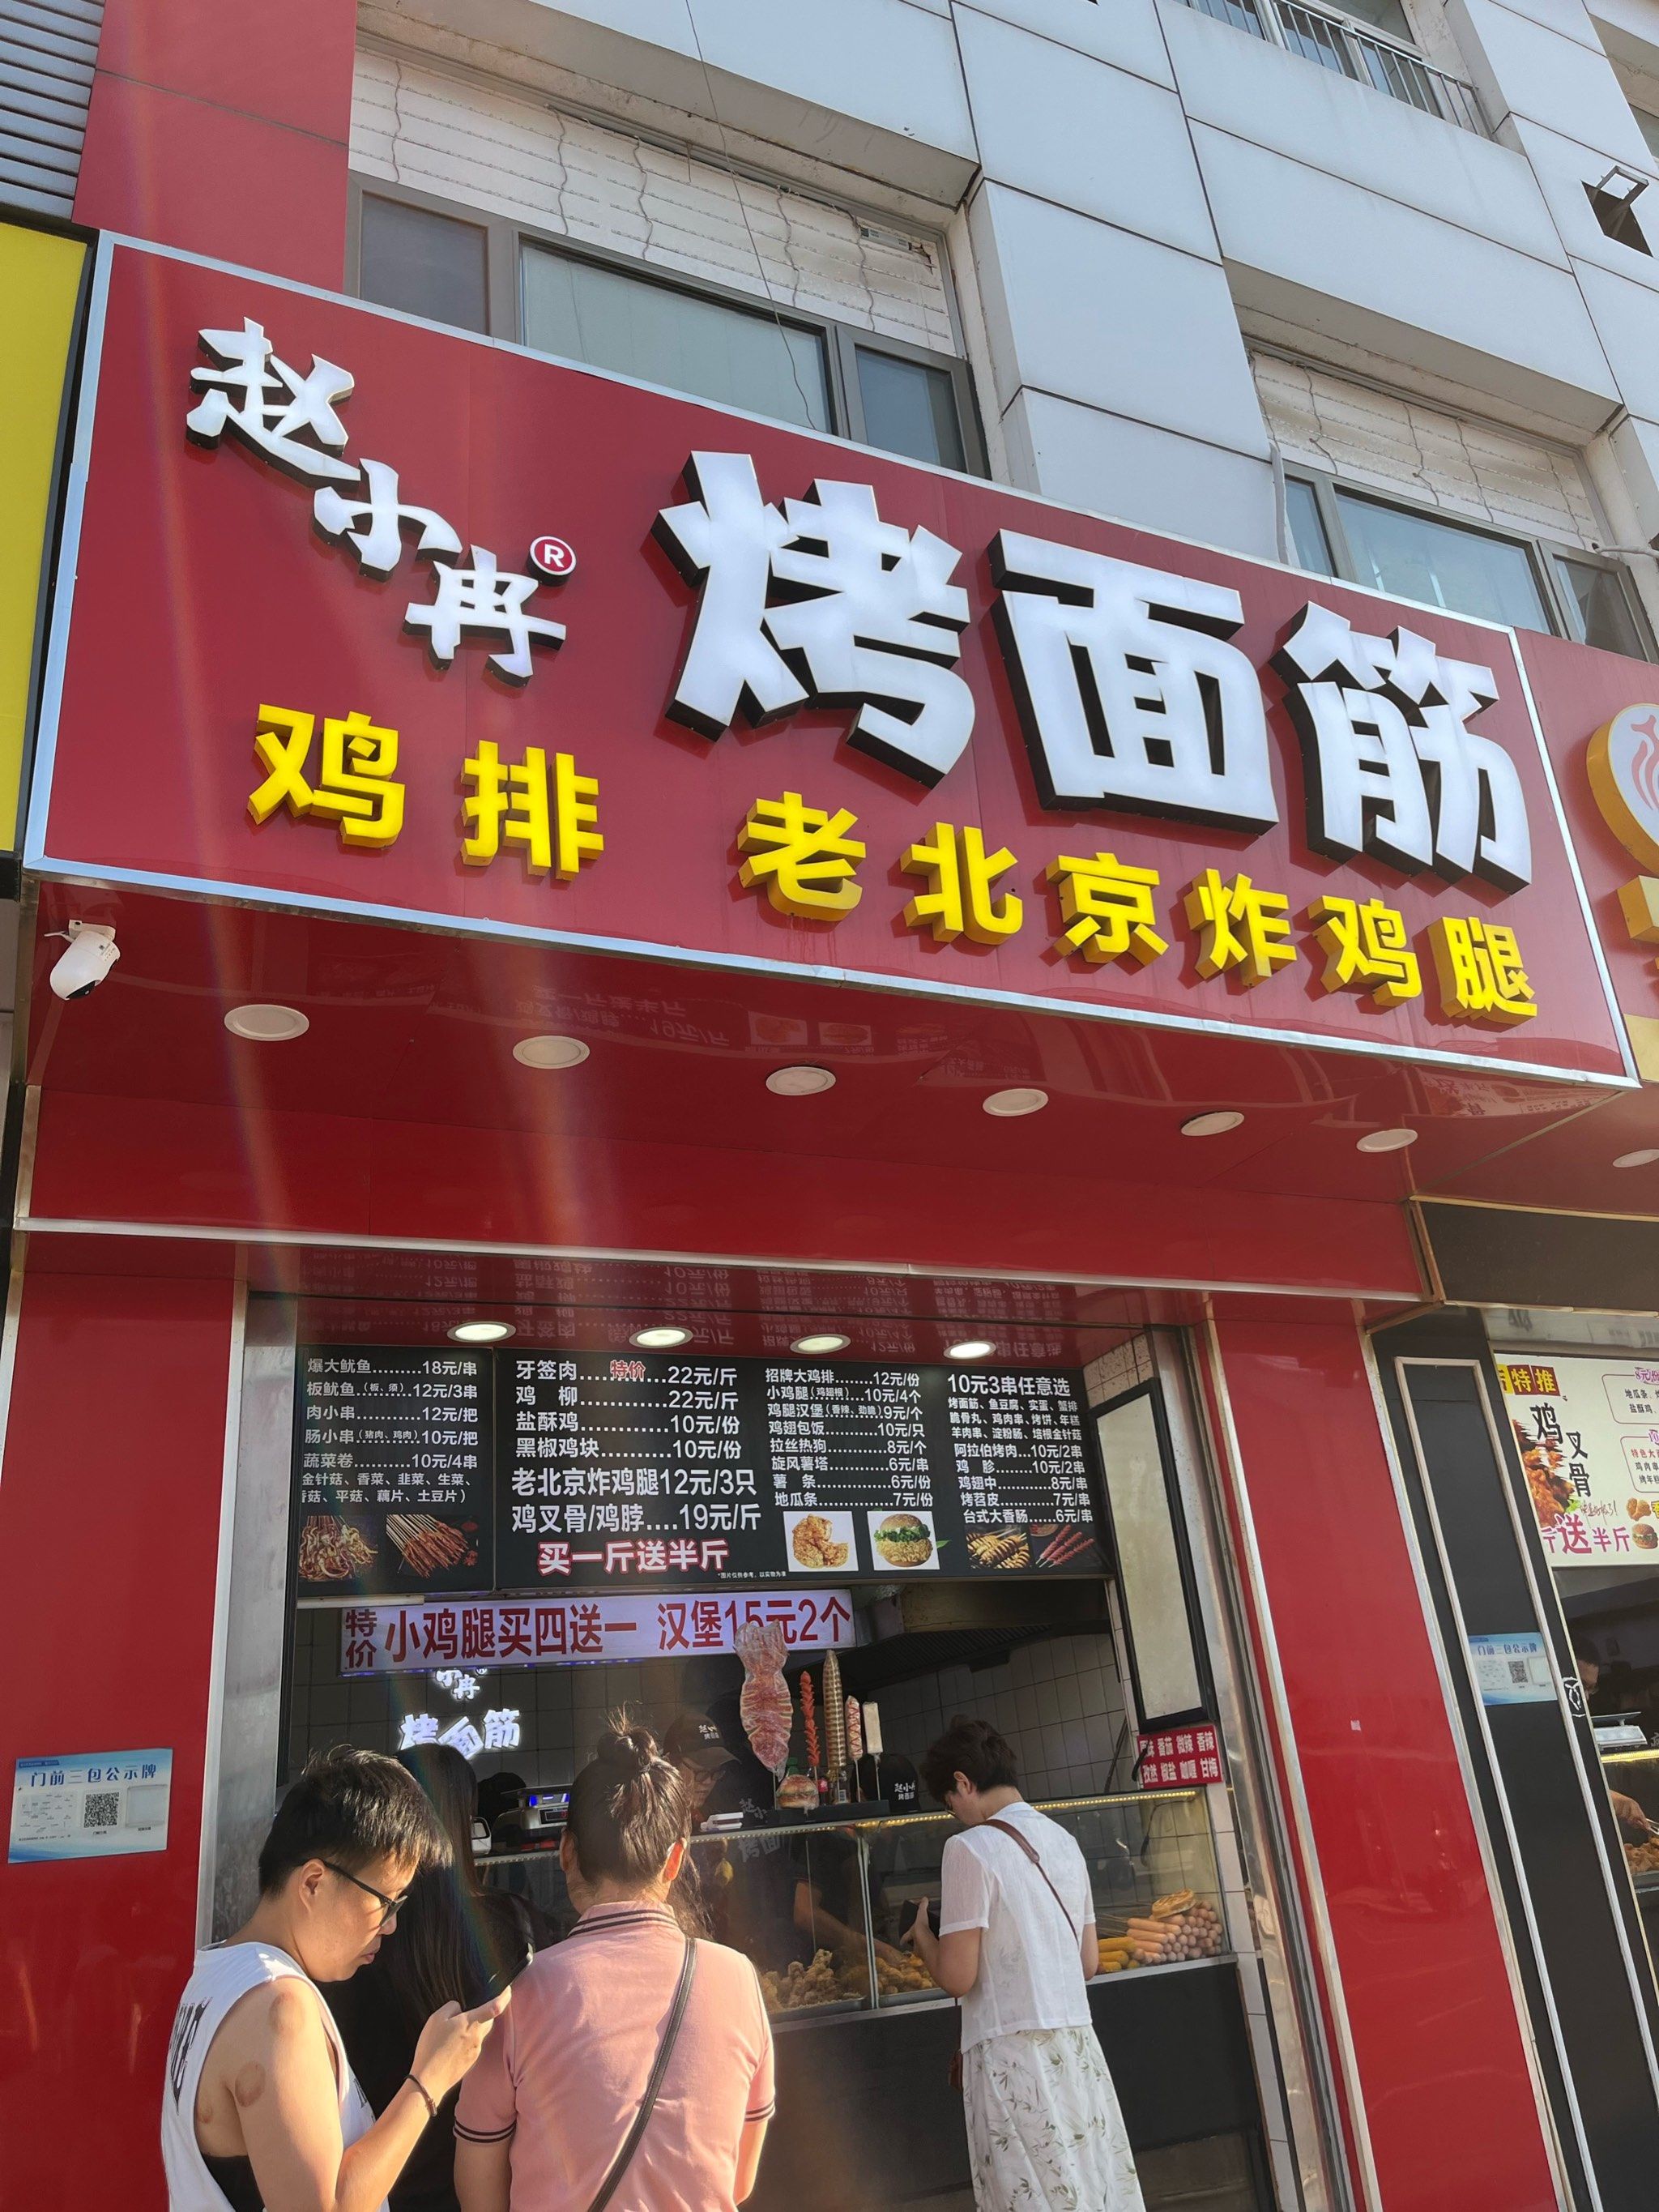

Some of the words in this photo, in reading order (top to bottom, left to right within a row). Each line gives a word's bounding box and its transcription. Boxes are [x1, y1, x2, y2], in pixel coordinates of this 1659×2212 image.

[186, 317, 567, 679] 赵小冉
[656, 450, 1533, 890] 烤面筋
[248, 703, 603, 878] 鸡排
[737, 791, 1539, 1024] 老北京炸鸡腿
[422, 1360, 477, 1377] 18元/串
[516, 1360, 577, 1381] 牙签肉
[610, 1360, 646, 1379] 特价
[667, 1366, 737, 1386] 22元/斤
[765, 1368, 834, 1384] 招牌大鸡排
[873, 1372, 919, 1386] 12元/份
[306, 1381, 355, 1397] 板鱿鱼
[413, 1384, 478, 1399] 12元/3串
[948, 1374, 1071, 1397] 10元3串任意选
[668, 1391, 739, 1411] 22元/斤
[766, 1386, 808, 1401] 小鸡腿
[864, 1389, 921, 1404] 10元/4个
[306, 1406, 355, 1420] 肉小串
[422, 1407, 478, 1423] 12元/把
[767, 1403, 824, 1418] 鸡腿汉堡
[884, 1406, 923, 1420] 9元/个
[516, 1411, 578, 1432] 盐酥鸡
[670, 1415, 740, 1435] 10元/份
[769, 1420, 825, 1436] 鸡翅包饭
[878, 1423, 925, 1437] 10元/只
[305, 1428, 354, 1445] 肠小串
[421, 1430, 478, 1446] 10元/把
[516, 1437, 599, 1458] 黑椒鸡块
[672, 1440, 741, 1459] 10元/份
[770, 1438, 826, 1454] 拉丝热狗
[887, 1440, 927, 1455] 8元/个
[954, 1443, 1019, 1458] 阿拉伯烤肉
[1030, 1445, 1082, 1458] 10元/2串
[1529, 1403, 1592, 1497] 鸡叉骨
[304, 1453, 353, 1468] 蔬菜卷
[412, 1454, 478, 1469] 10元/4串
[771, 1456, 829, 1471] 旋风薯塔
[889, 1458, 929, 1472] 6元/串
[1032, 1461, 1085, 1475] 10元/2串
[891, 1475, 931, 1489] 6元/份
[958, 1476, 997, 1491] 鸡翅中
[1051, 1476, 1088, 1491] 8元/串
[774, 1492, 817, 1507] 地瓜条
[893, 1492, 933, 1507] 7元/份
[1053, 1492, 1090, 1507] 7元/串
[679, 1503, 761, 1531] 19元/斤
[962, 1510, 1028, 1524] 台式大香肠
[1056, 1510, 1094, 1524] 6元/串
[538, 1539, 729, 1575] 买一斤送半斤
[345, 1608, 377, 1669] 特价
[384, 1602, 638, 1661] 小鸡腿买四送一
[399, 1708, 520, 1760] 烤面筋
[31, 1763, 157, 1787] 门前三包公示牌
